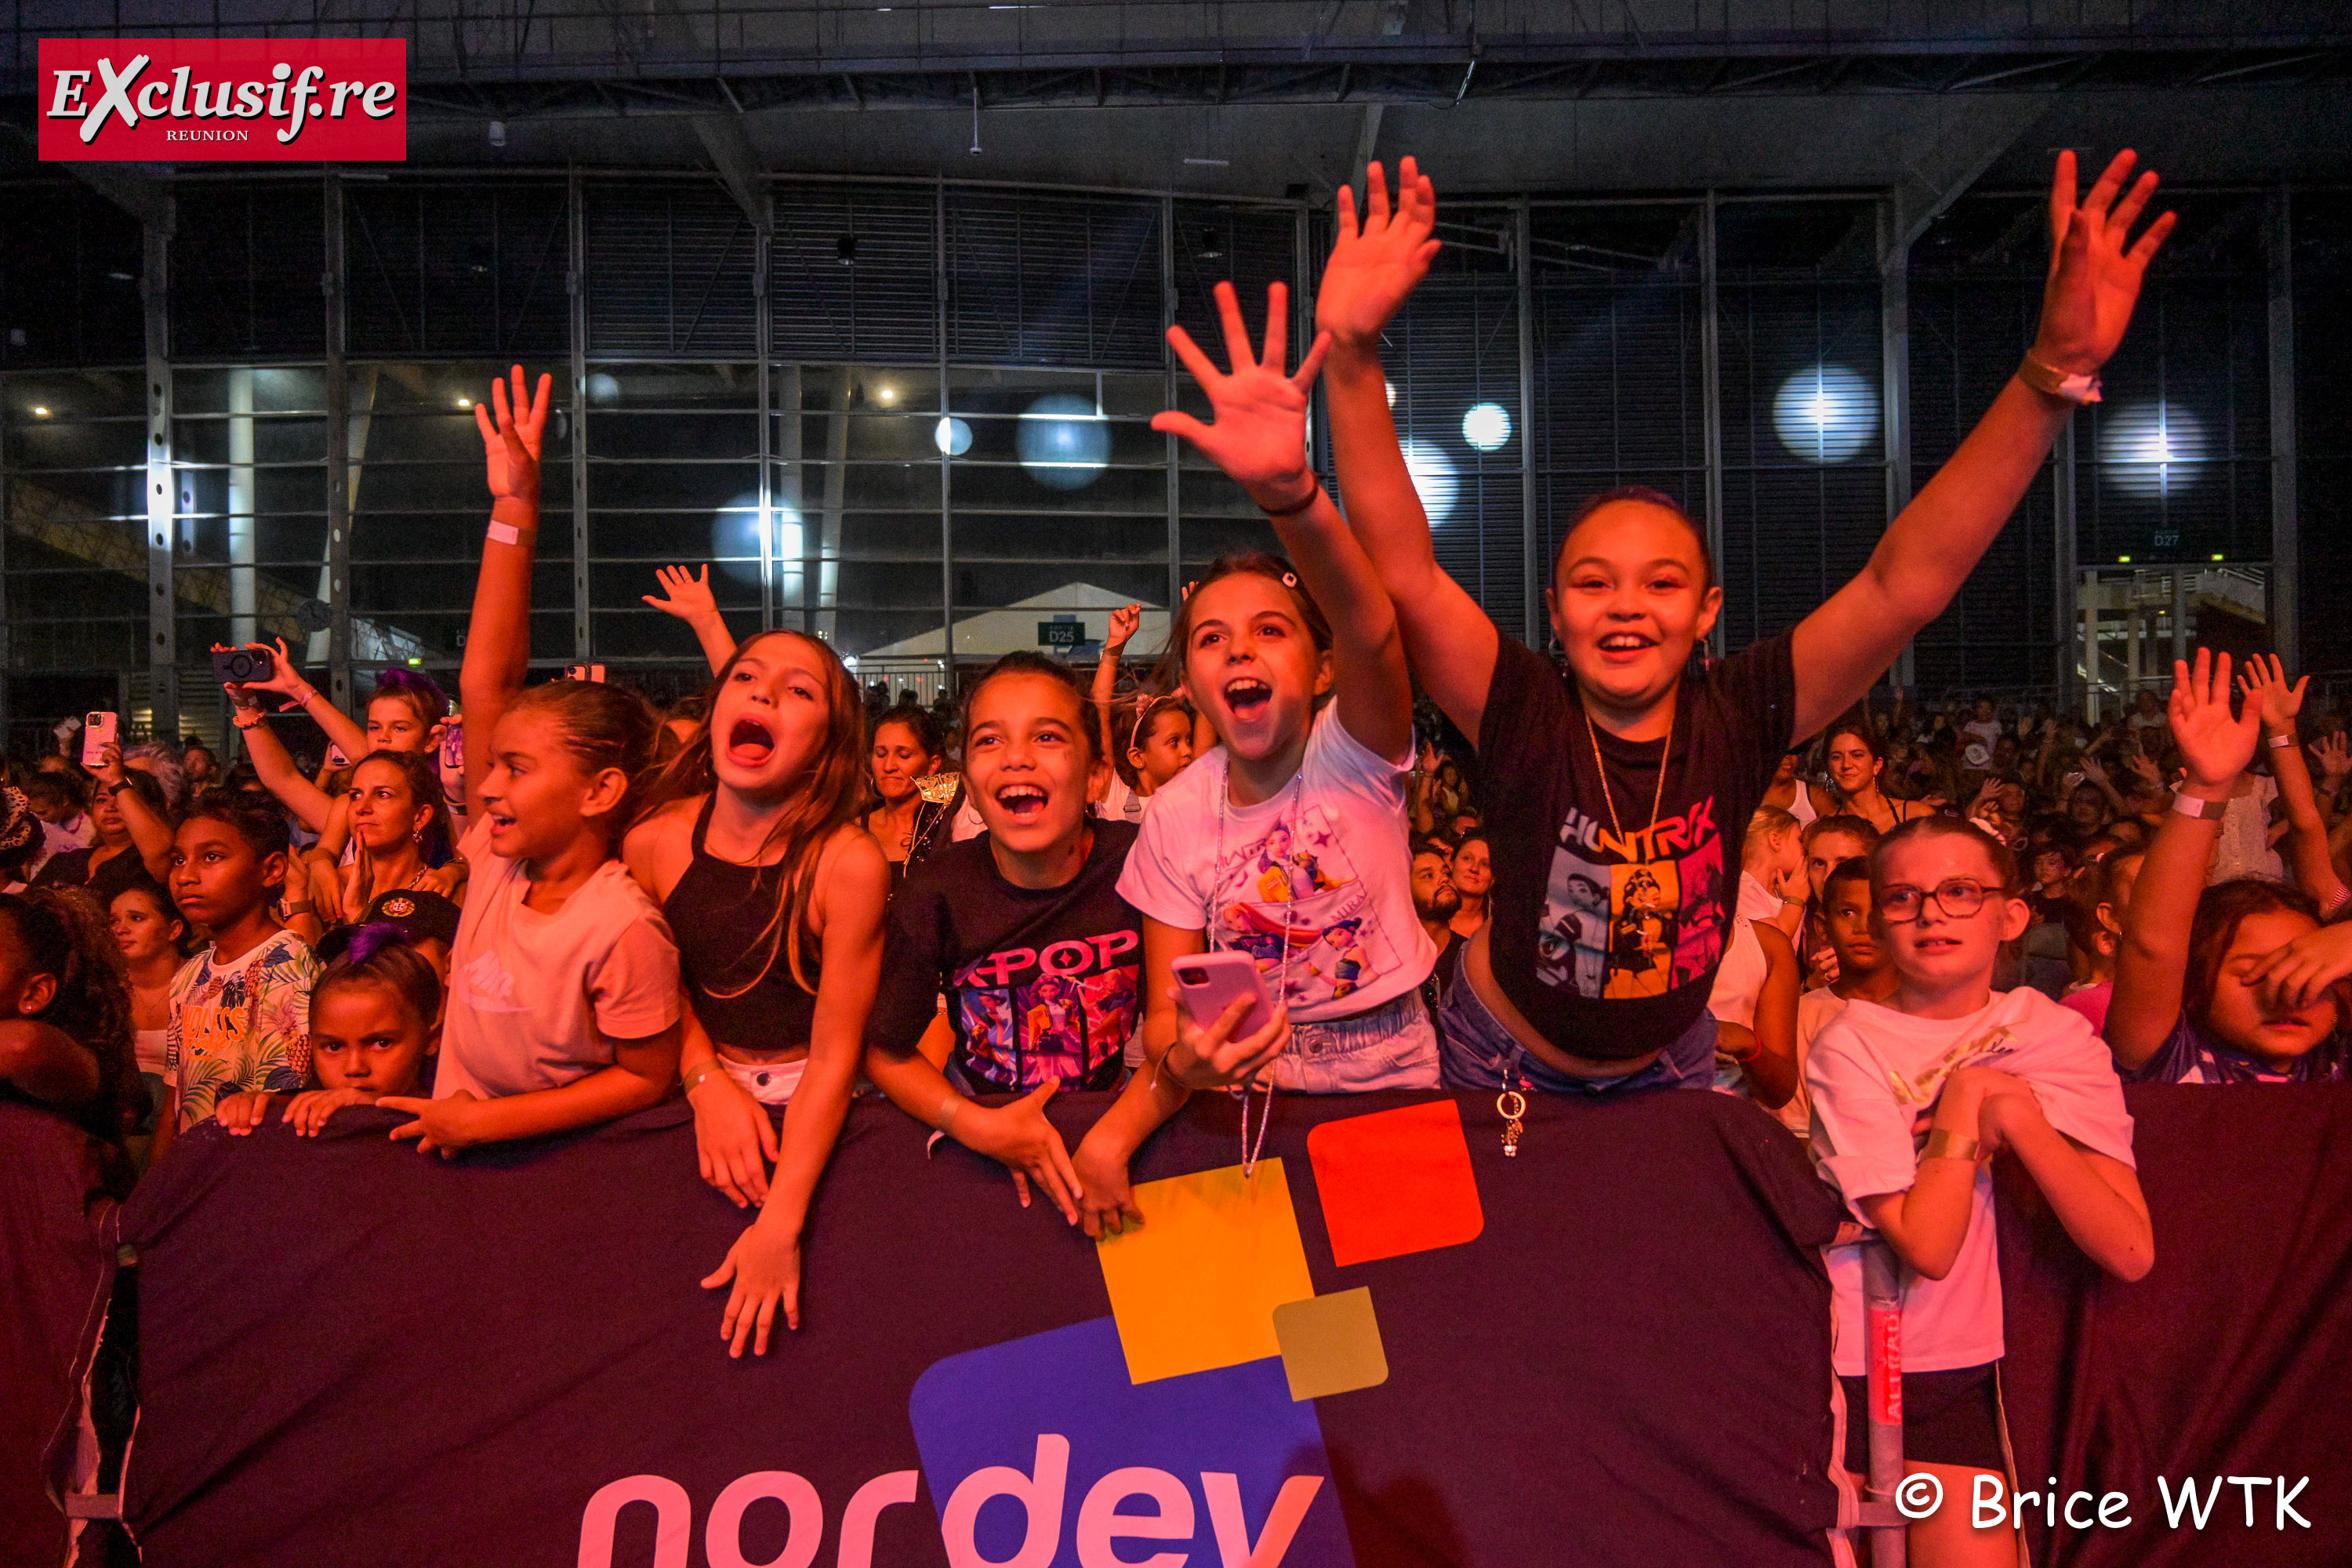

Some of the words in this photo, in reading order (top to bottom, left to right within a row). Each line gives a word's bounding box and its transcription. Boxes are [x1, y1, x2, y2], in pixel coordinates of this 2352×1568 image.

[2154, 535, 2180, 546] D27
[1049, 630, 1075, 643] D25
[1330, 895, 1366, 922] MIRA
[576, 1433, 1325, 1568] nordev
